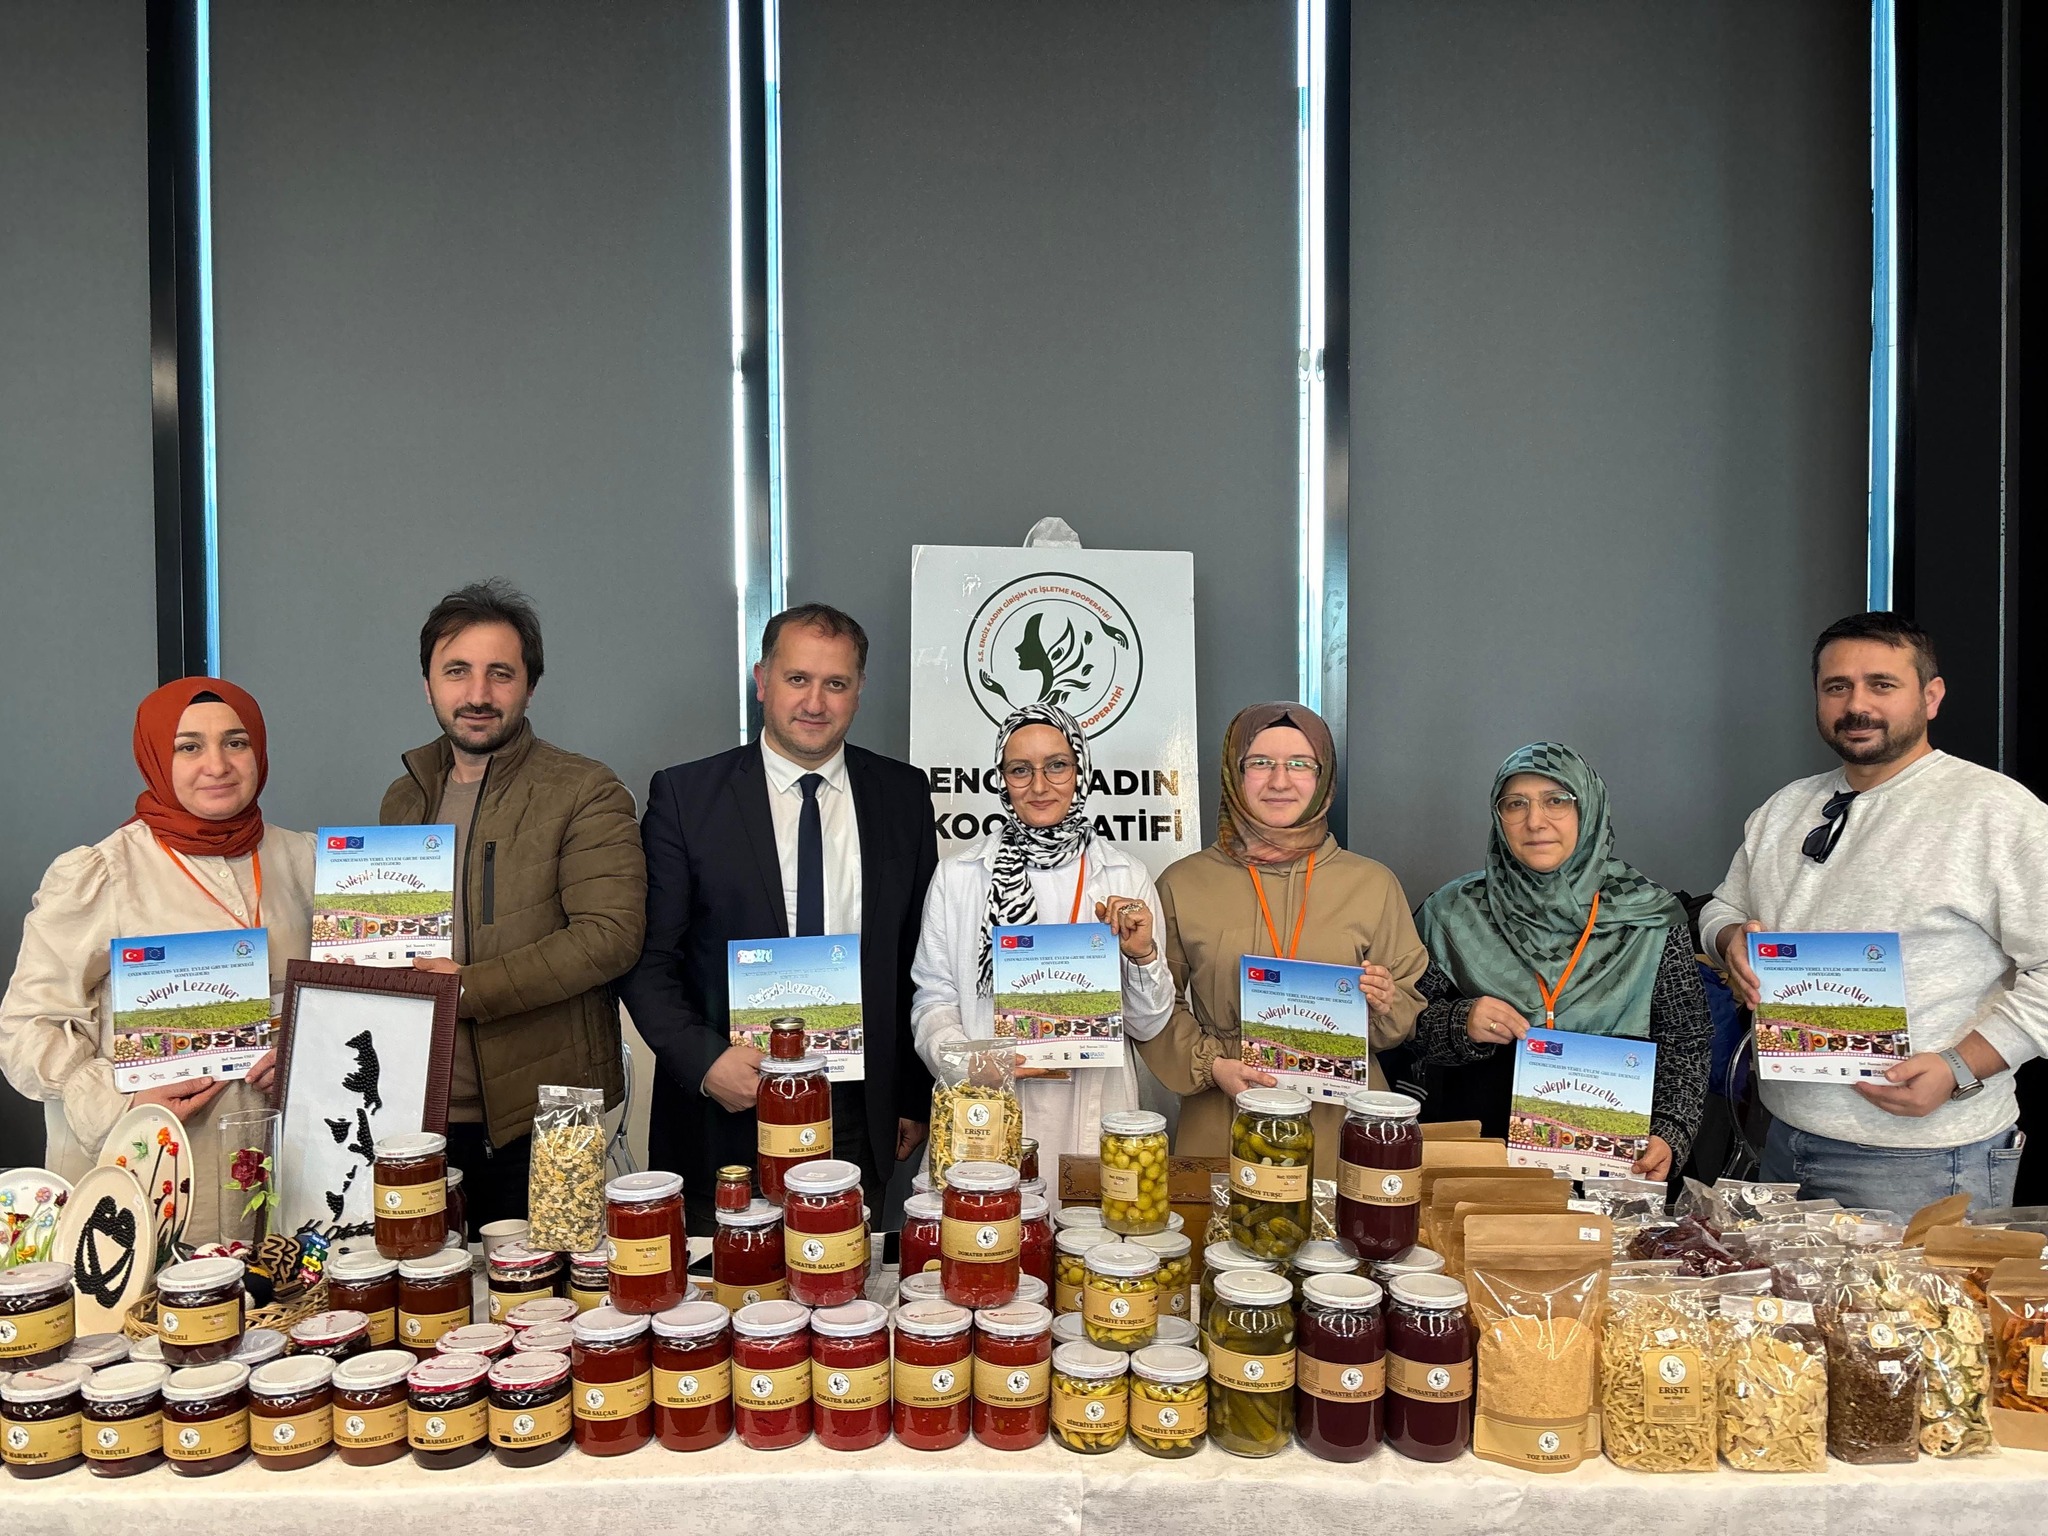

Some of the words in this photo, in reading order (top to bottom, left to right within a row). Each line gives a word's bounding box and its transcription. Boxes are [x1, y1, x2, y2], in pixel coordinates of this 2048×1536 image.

[987, 607, 1004, 628] KADIN
[1003, 591, 1028, 608] GİRİŞİM
[1039, 585, 1069, 595] İŞLETME
[1071, 590, 1113, 621] KOOPERATİFİ
[1081, 685, 1125, 728] OOPERATİFİ
[1088, 770, 1179, 796] ADIN
[377, 867, 426, 890] Lezzetler
[1011, 968, 1044, 991] Salepli
[1048, 967, 1094, 989] Lezzetler
[136, 982, 179, 1007] Salepli
[183, 979, 240, 1000] Lezzetler
[1773, 980, 1812, 1001] Salepli
[1816, 978, 1873, 1004] Lezzetler
[1257, 1004, 1291, 1022] Salepli
[1293, 1004, 1339, 1031] Lezzetler
[1533, 1078, 1571, 1097] Salepli
[1574, 1078, 1623, 1107] Lezzetler
[1263, 1190, 1283, 1199] TURŞU
[790, 1259, 817, 1269] DOMATES
[818, 1262, 845, 1270] SALÇASI
[1237, 1379, 1269, 1390] KORNİŞON
[685, 1394, 712, 1404] SALÇASI
[738, 1397, 765, 1406] DOMATES
[767, 1397, 795, 1406] SALÇASI
[816, 1393, 842, 1404] DOMATES
[843, 1396, 872, 1405] SALÇASI
[988, 1393, 1013, 1402] DOMATES
[592, 1409, 618, 1418] SALÇASI
[354, 1432, 394, 1443] MARMELATI
[424, 1435, 464, 1445] MARMELATI
[513, 1432, 552, 1443] MARMELATI
[283, 1437, 323, 1450] MARMELATI
[105, 1447, 130, 1456] REÇELİ
[187, 1447, 212, 1457] REÇELİ
